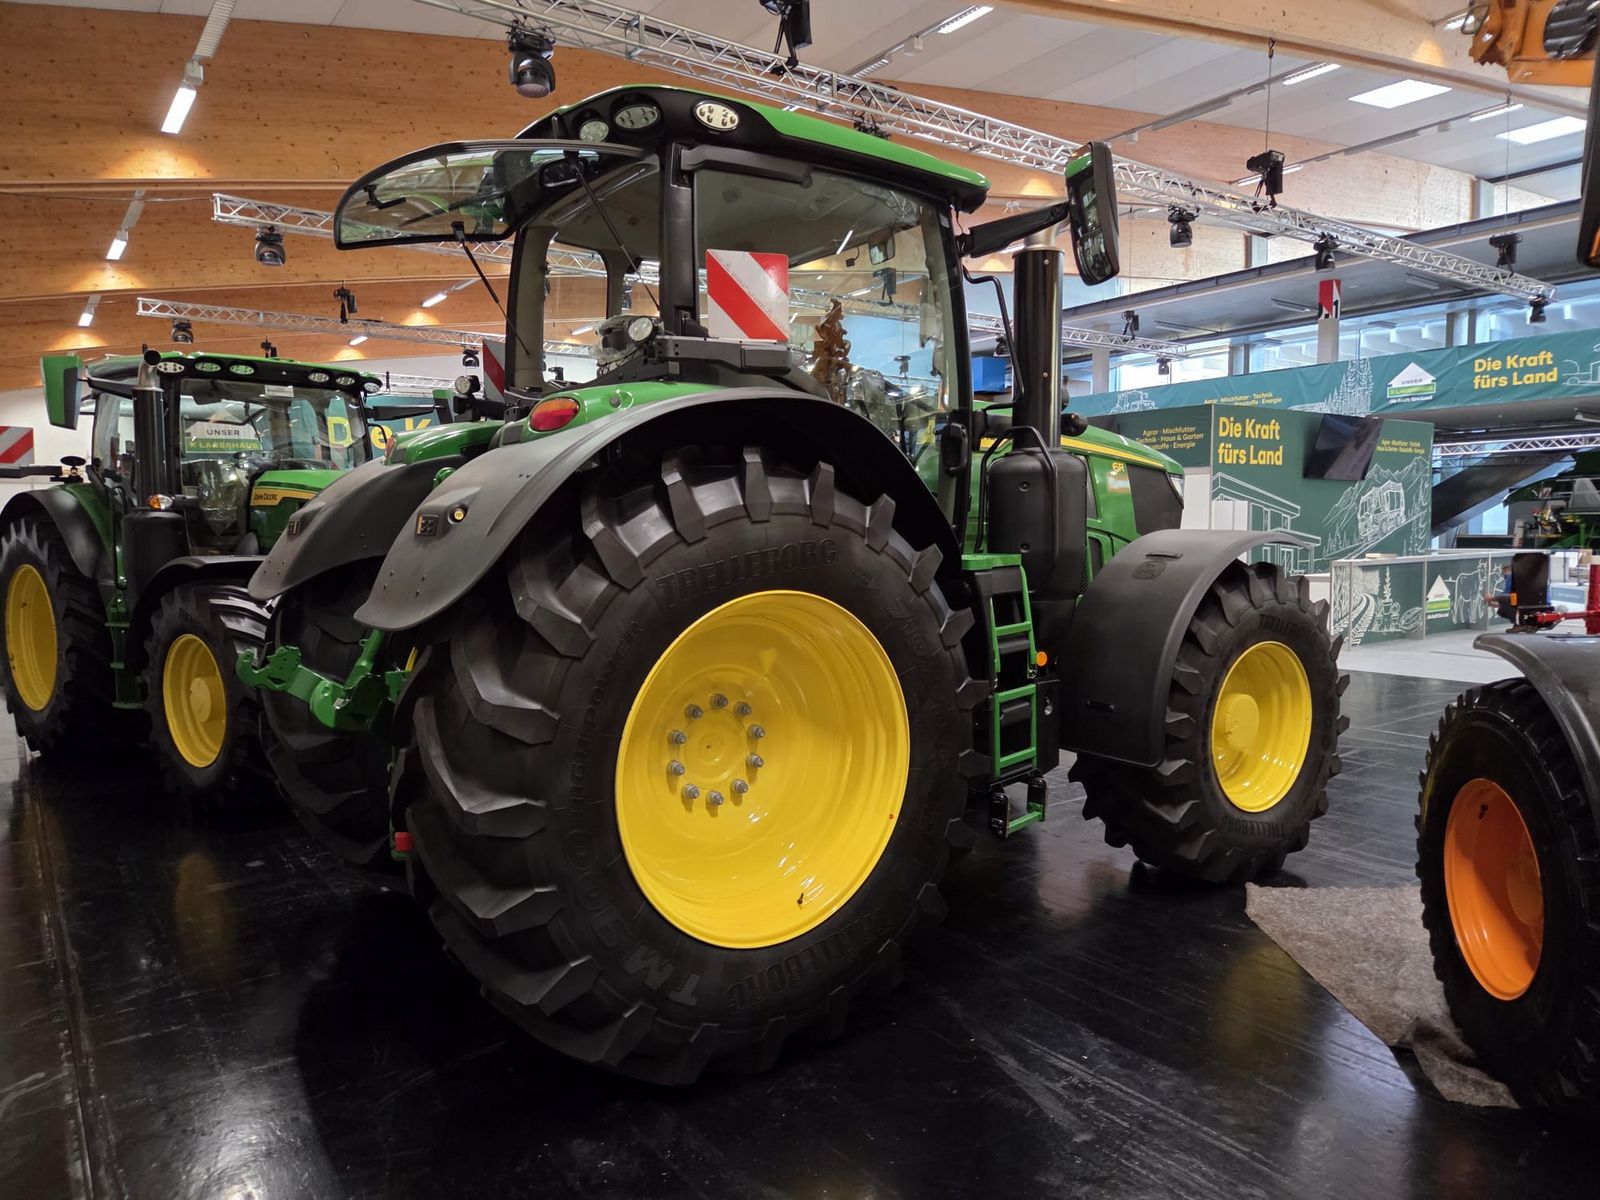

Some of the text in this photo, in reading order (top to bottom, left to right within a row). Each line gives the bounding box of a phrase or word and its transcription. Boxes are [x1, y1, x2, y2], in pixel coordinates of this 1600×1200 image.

[1474, 350, 1553, 372] Die Kraft
[1473, 367, 1558, 389] fürs Land
[1163, 426, 1196, 435] Mischfutter
[1218, 416, 1280, 440] Die Kraft
[200, 441, 258, 449] LAGERHAUS
[1172, 441, 1196, 449] Energie
[1217, 442, 1283, 466] fürs Land
[655, 537, 837, 608] TRELLEBORG
